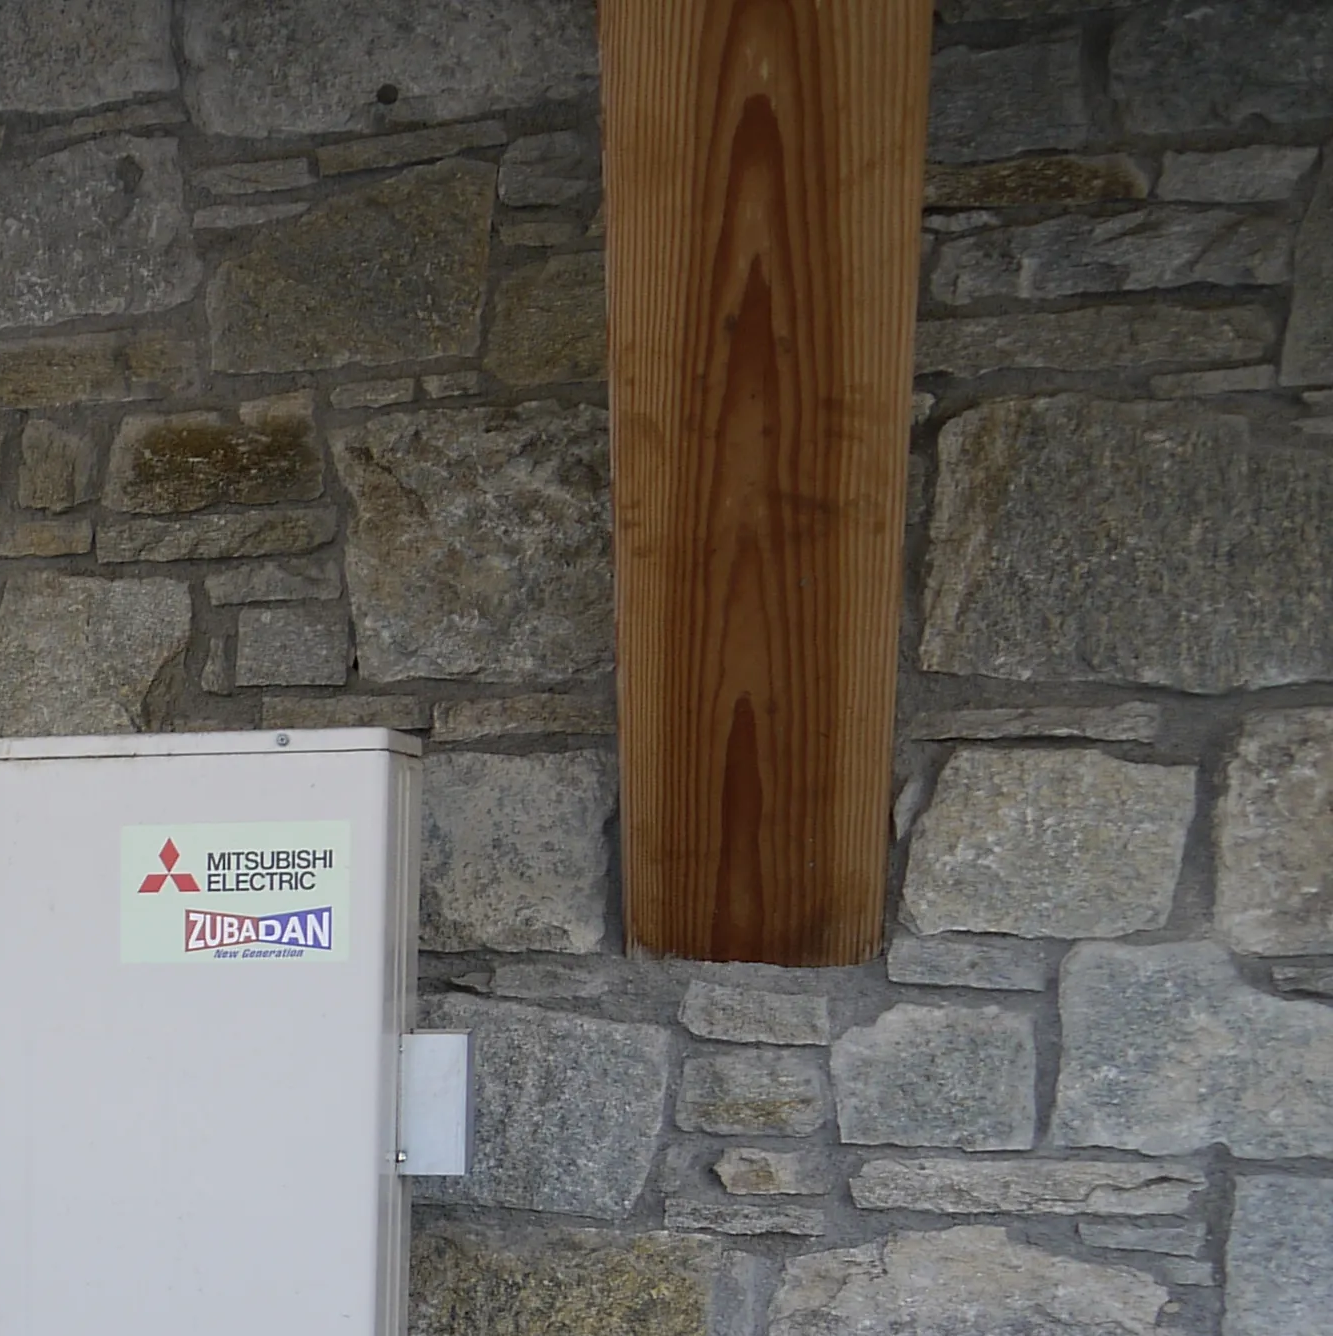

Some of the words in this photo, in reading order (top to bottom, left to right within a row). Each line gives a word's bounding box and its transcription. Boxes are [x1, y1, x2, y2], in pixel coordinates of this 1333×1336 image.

[207, 849, 333, 872] MITSUBISHI
[207, 872, 316, 892] ELECTRIC
[188, 911, 330, 949] ZUBADAN
[214, 949, 239, 959] New
[242, 949, 304, 959] Generation
